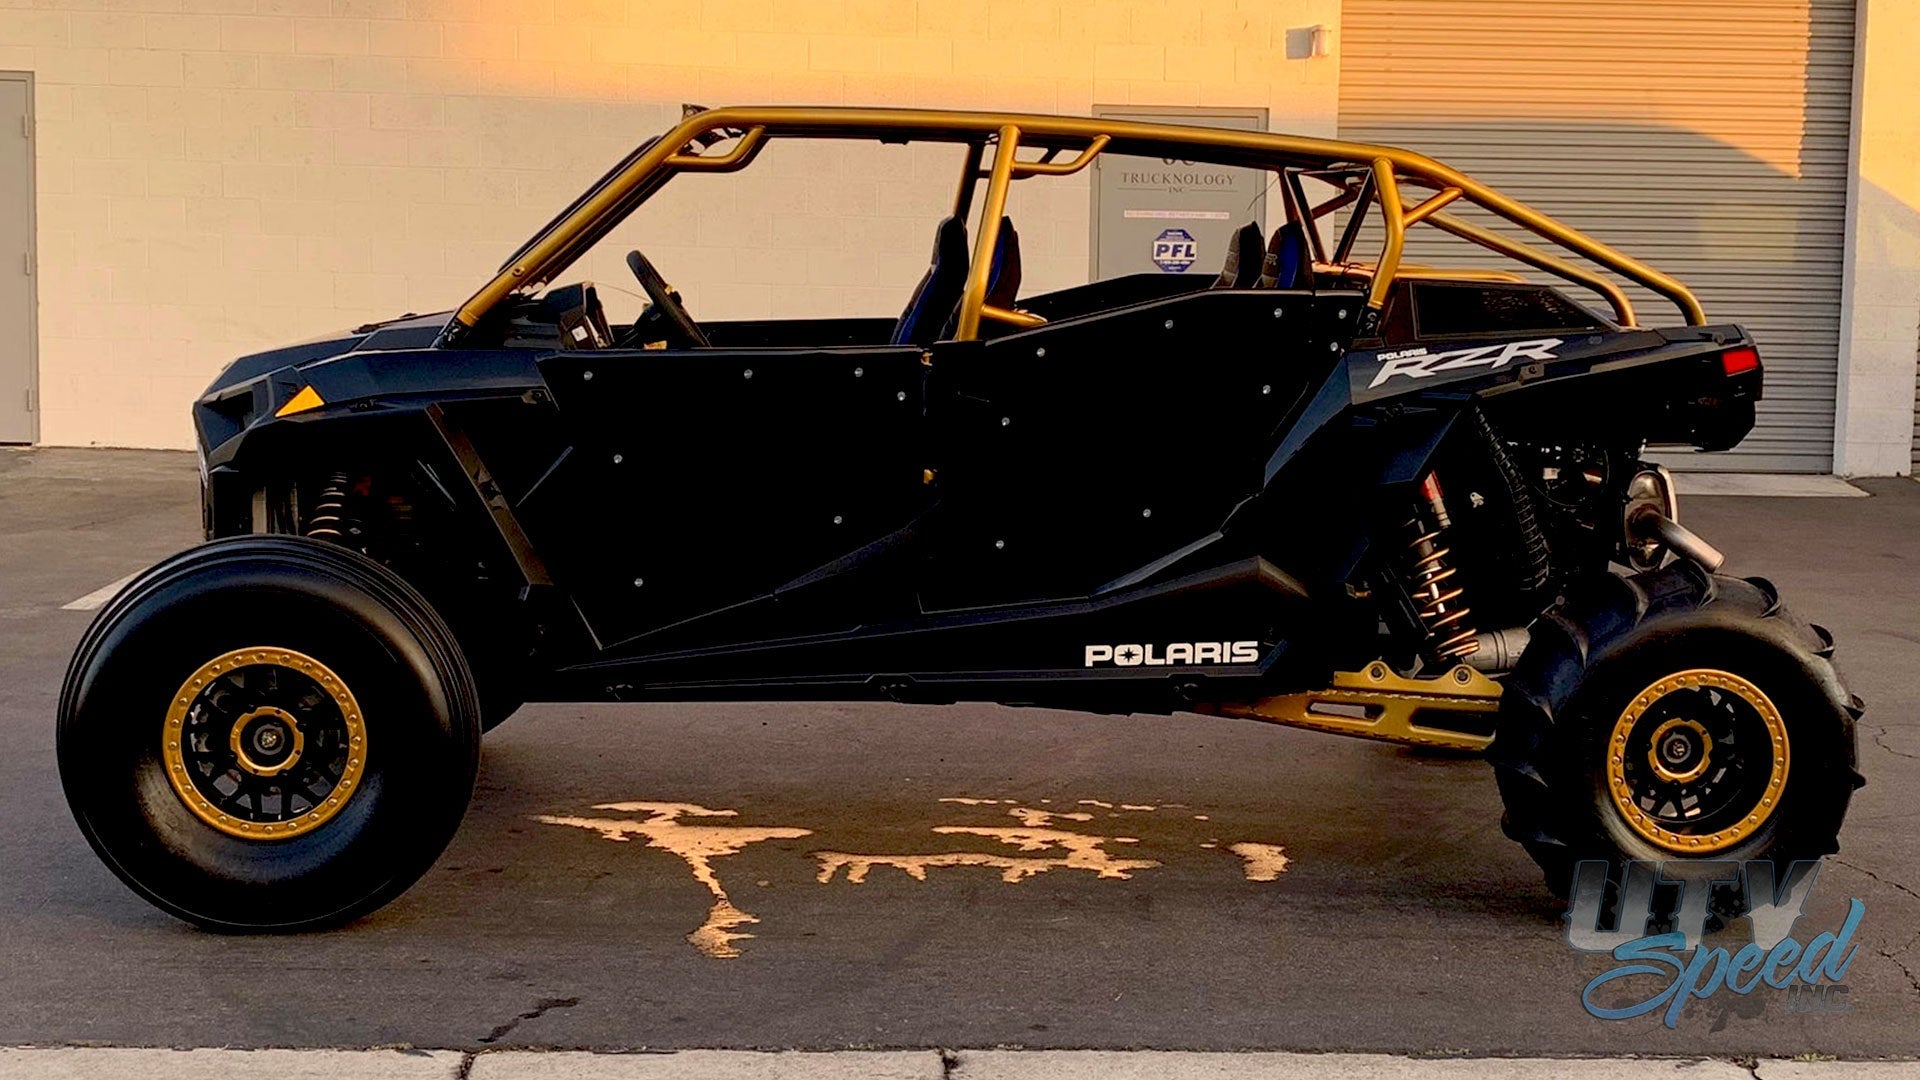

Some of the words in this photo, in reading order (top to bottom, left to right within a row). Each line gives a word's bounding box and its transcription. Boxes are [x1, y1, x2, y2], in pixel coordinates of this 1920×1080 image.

[1122, 172, 1235, 186] TRUCKNOLOGY
[1156, 244, 1195, 258] PFL
[1377, 348, 1428, 362] POLARIS
[1368, 338, 1564, 388] RZR
[1085, 641, 1259, 667] POLARIS
